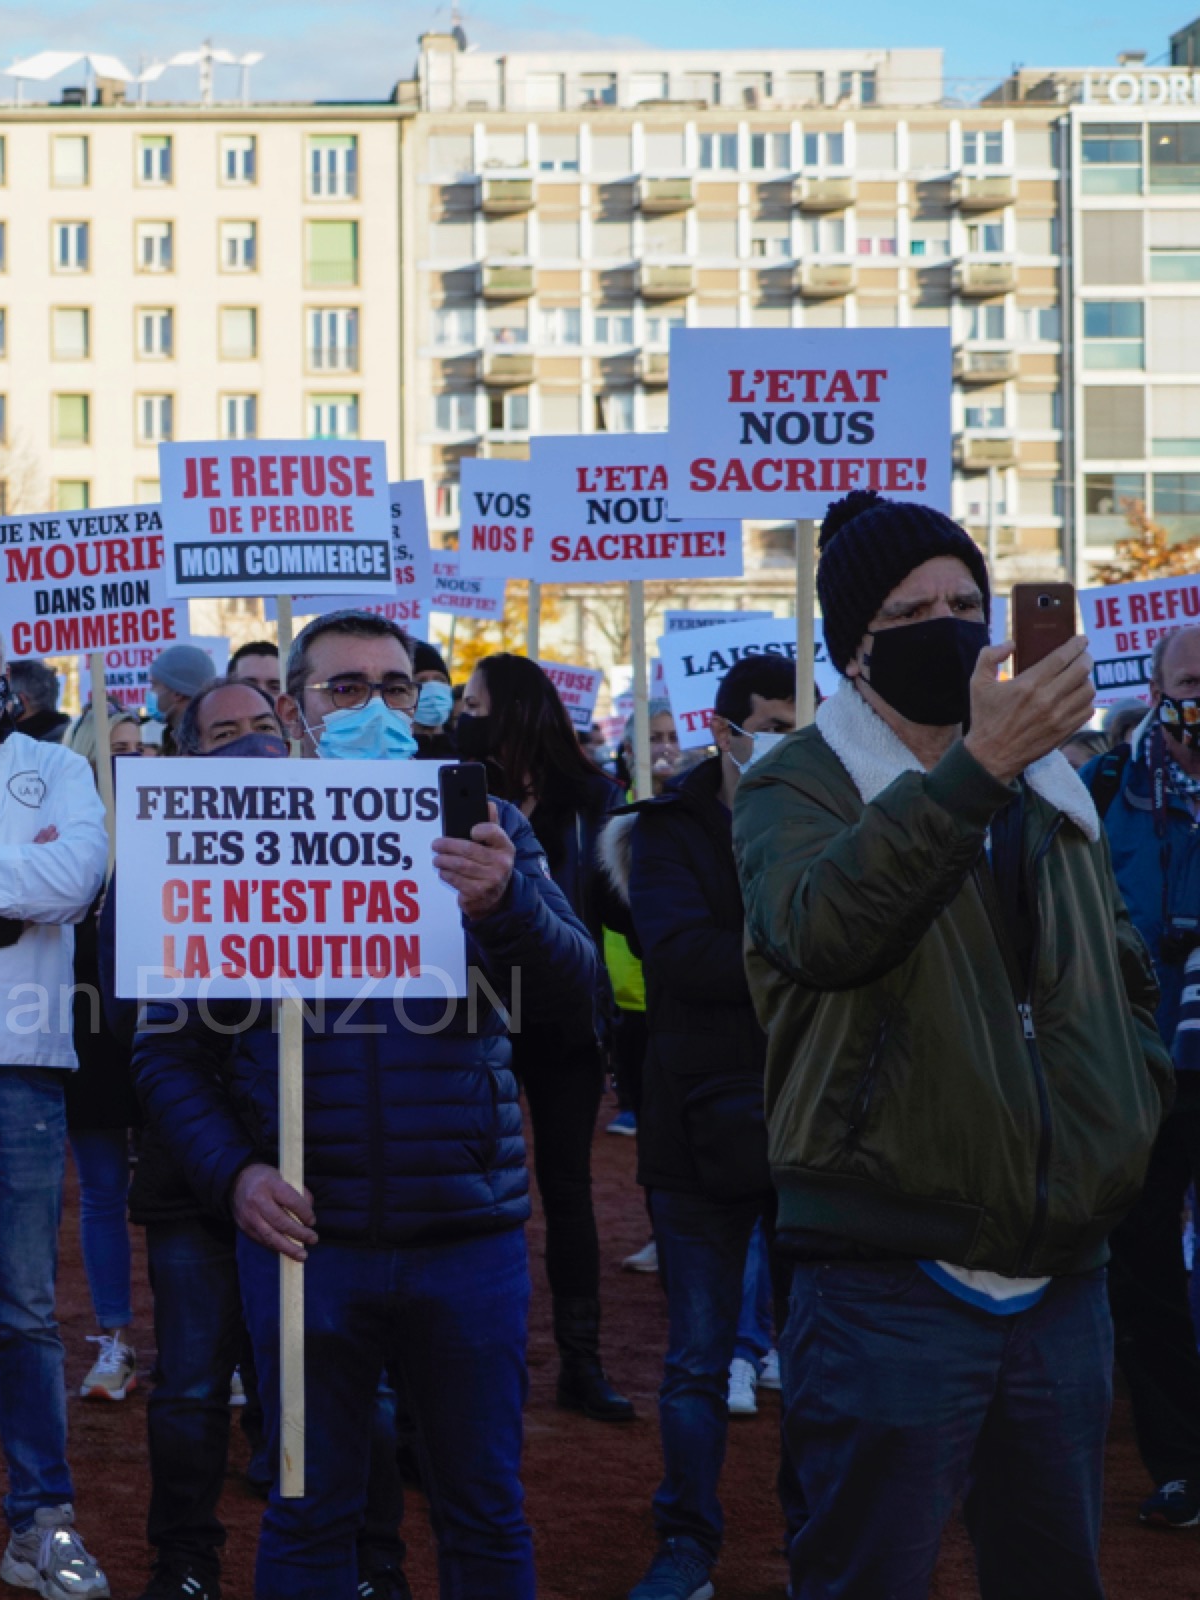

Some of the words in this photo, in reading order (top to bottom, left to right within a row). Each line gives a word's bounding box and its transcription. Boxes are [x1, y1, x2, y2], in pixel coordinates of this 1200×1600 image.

[728, 369, 888, 403] L'ETAT
[739, 411, 875, 445] NOUS
[183, 457, 221, 498] JE
[231, 455, 375, 498] REFUSE
[576, 464, 669, 493] L'ETA
[689, 457, 927, 492] SACRIFIE!
[209, 506, 243, 534] DE
[250, 504, 354, 533] PERDRE
[473, 491, 531, 519] VOS
[586, 497, 684, 525] NOU
[29, 520, 61, 541] NE
[67, 513, 129, 538] VEUX
[135, 511, 163, 532] PA
[471, 525, 517, 552] NOS
[180, 546, 239, 577] MON
[245, 543, 388, 575] COMMERCE
[551, 531, 727, 563] SACRIFIE!
[34, 584, 98, 616] DANS
[101, 579, 150, 609] MON
[435, 578, 481, 593] NOUS
[1095, 597, 1123, 629] JE
[1128, 586, 1200, 625] REFU
[11, 607, 177, 656] COMMERCE
[1115, 630, 1141, 653] DE
[1096, 658, 1140, 685] MON
[136, 786, 316, 821] FERMER
[326, 787, 439, 822] TOUS
[166, 831, 244, 866] LES
[255, 831, 280, 866] 3
[290, 832, 413, 870] MOIS,
[162, 878, 212, 924] CE
[223, 879, 332, 923] N'EST
[342, 879, 420, 923] PAS
[163, 935, 210, 978] LA
[221, 934, 421, 979] SOLUTION
